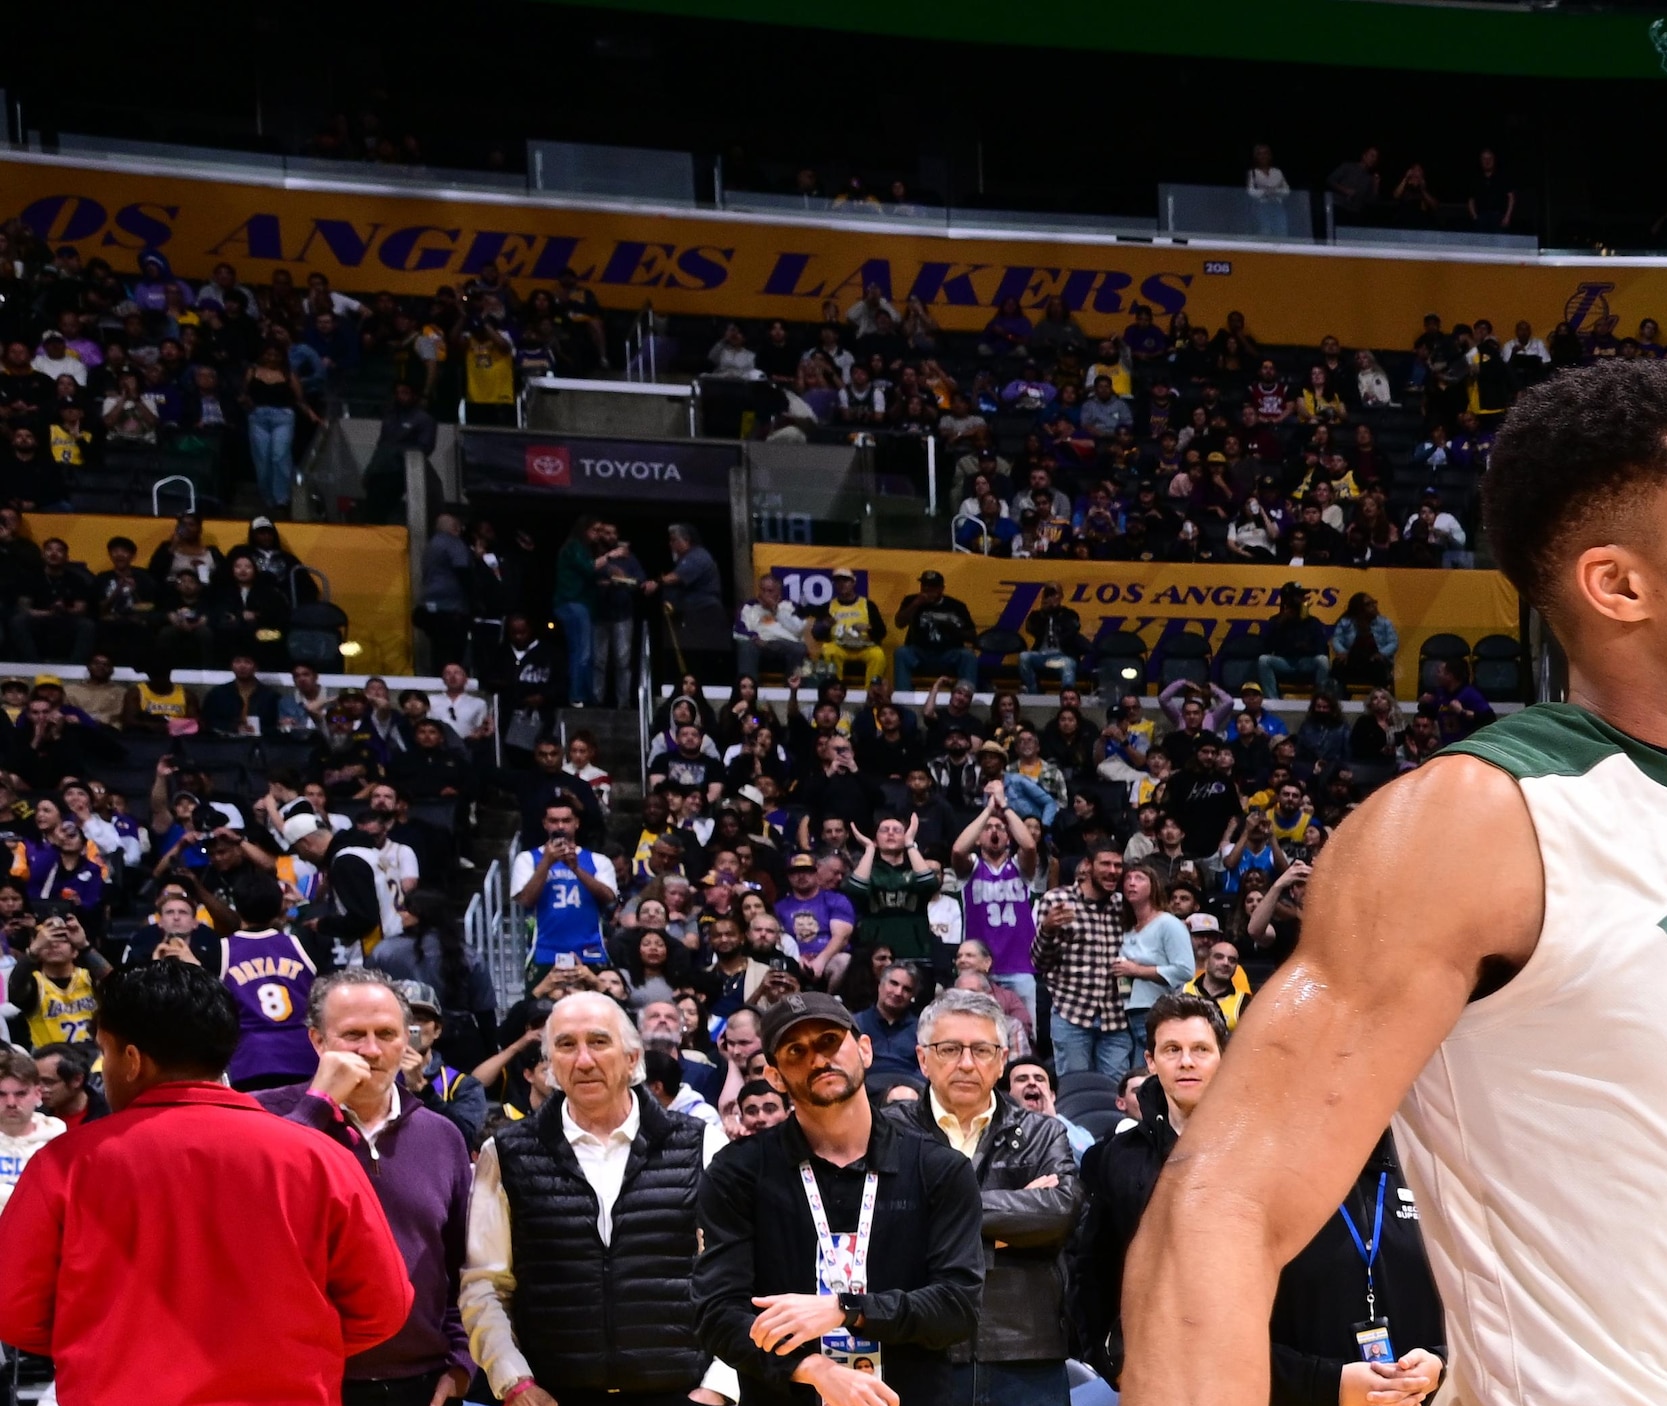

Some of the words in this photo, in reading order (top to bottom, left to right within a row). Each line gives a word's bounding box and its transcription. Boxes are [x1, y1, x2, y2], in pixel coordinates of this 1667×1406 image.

[208, 213, 734, 290] ANGELES
[763, 252, 1194, 317] LAKERS
[580, 458, 681, 482] TOYOTA
[772, 573, 830, 606] 10
[1071, 584, 1147, 604] LOS
[552, 884, 582, 910] 34
[971, 876, 1027, 906] BUCKS
[986, 902, 1017, 928] 34
[228, 956, 305, 986] BRYANT
[256, 983, 294, 1022] 8
